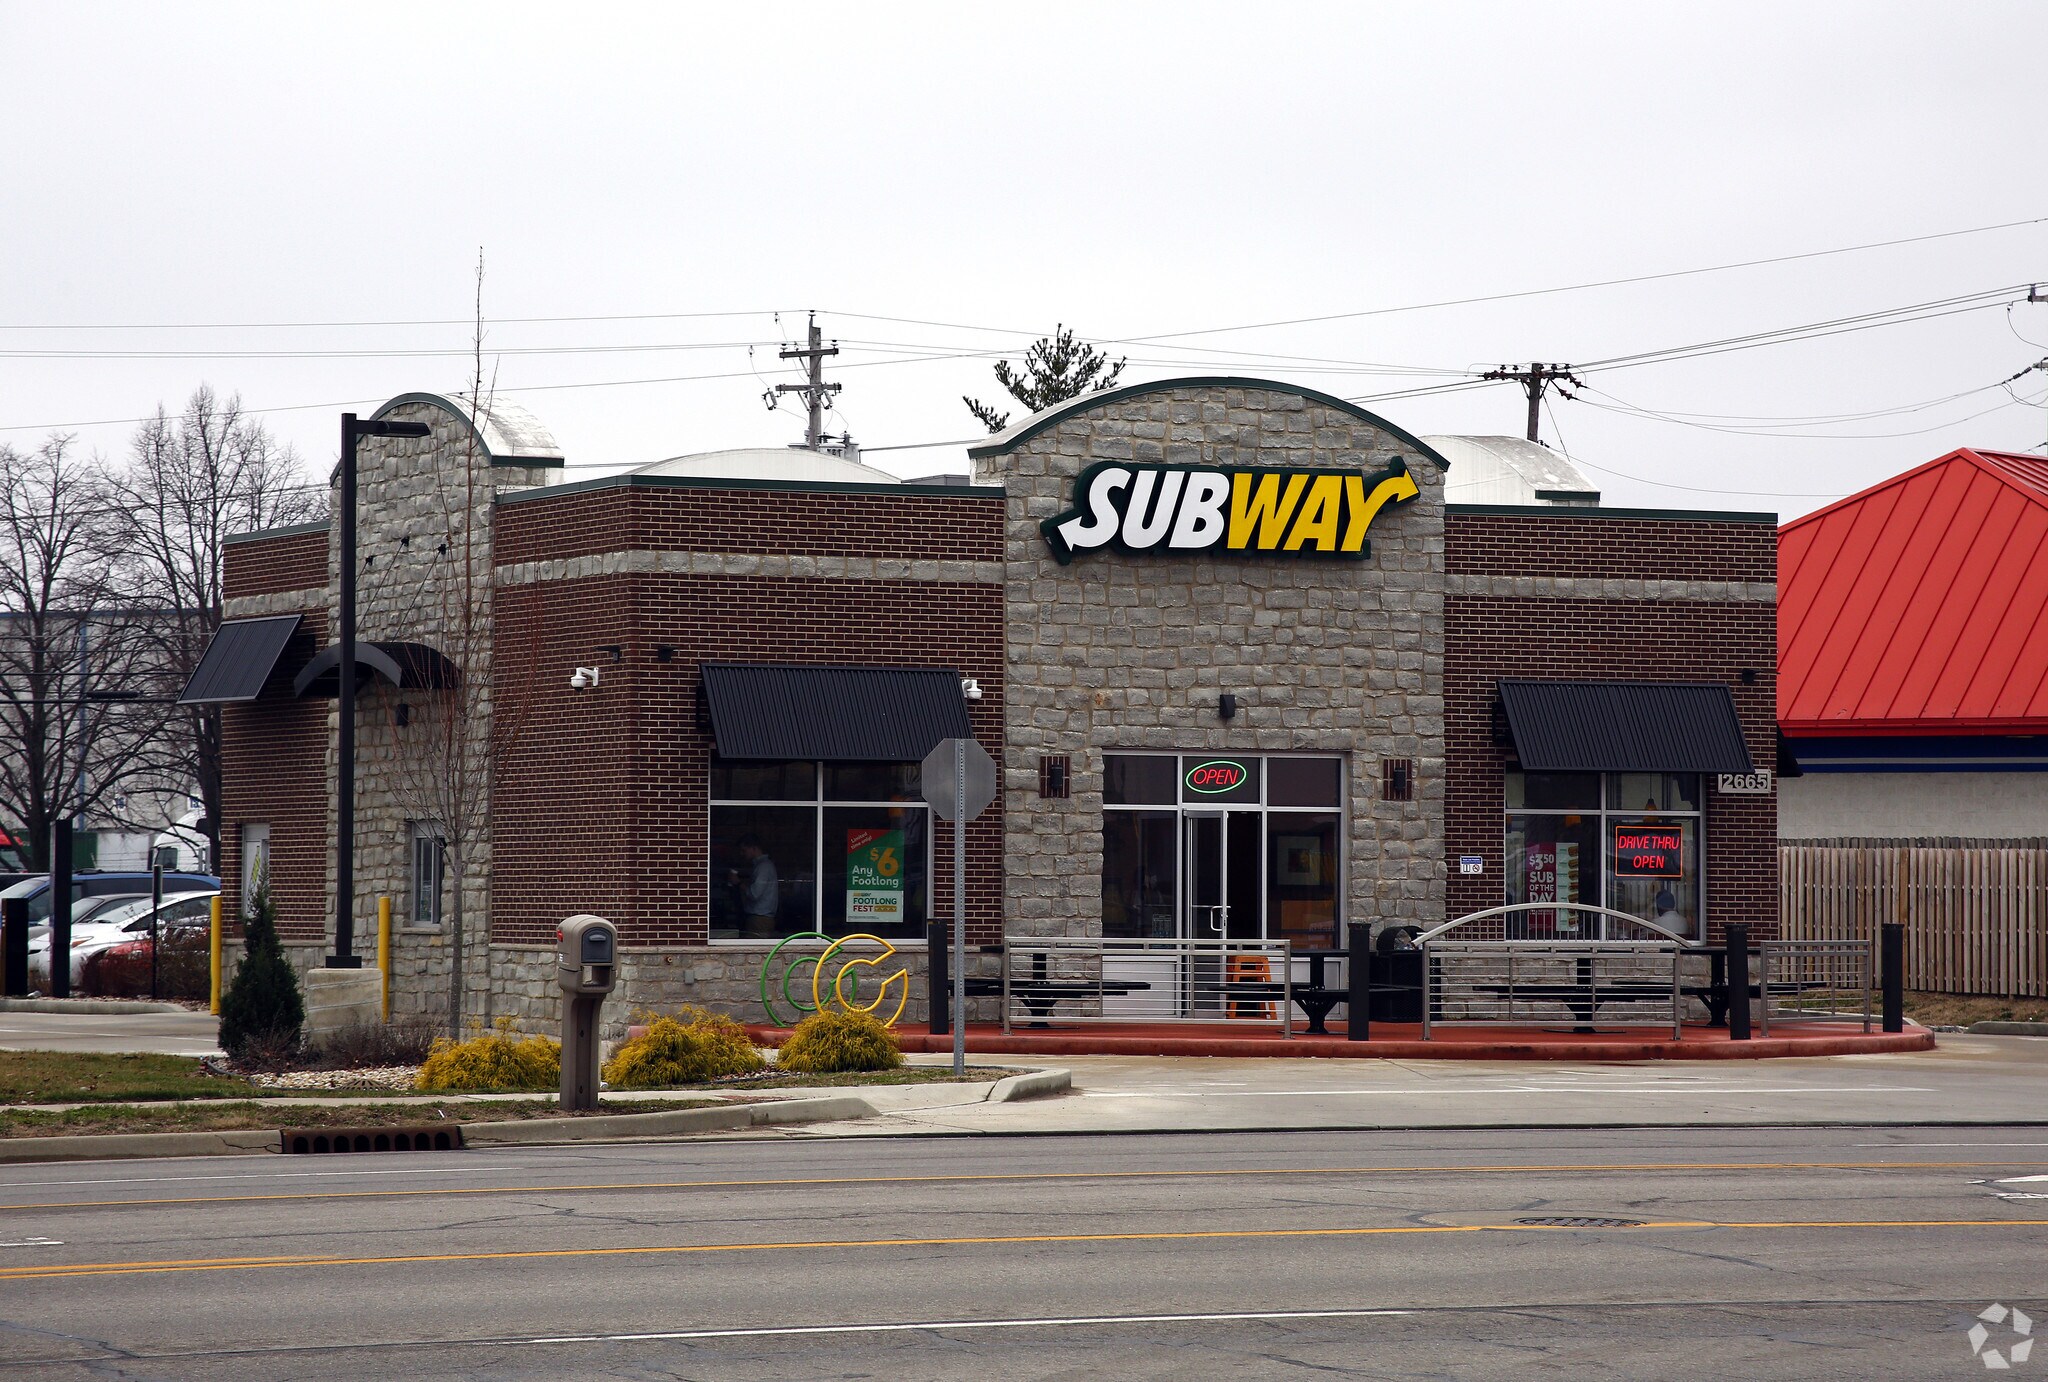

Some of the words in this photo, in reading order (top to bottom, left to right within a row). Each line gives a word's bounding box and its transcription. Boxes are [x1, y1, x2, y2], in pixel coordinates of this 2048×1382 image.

[1057, 467, 1420, 552] SUBWAY
[1193, 768, 1239, 785] OPEN
[1722, 773, 1767, 790] 2665
[1618, 835, 1650, 849] DRIVE
[1651, 836, 1680, 850] THRU
[870, 847, 899, 877] $6
[1633, 855, 1665, 869] OPEN
[852, 864, 873, 877] Any
[1530, 871, 1555, 883] SUB
[852, 875, 899, 888] Footlong
[853, 897, 897, 905] FOOTLONG
[1530, 892, 1555, 903] DAY
